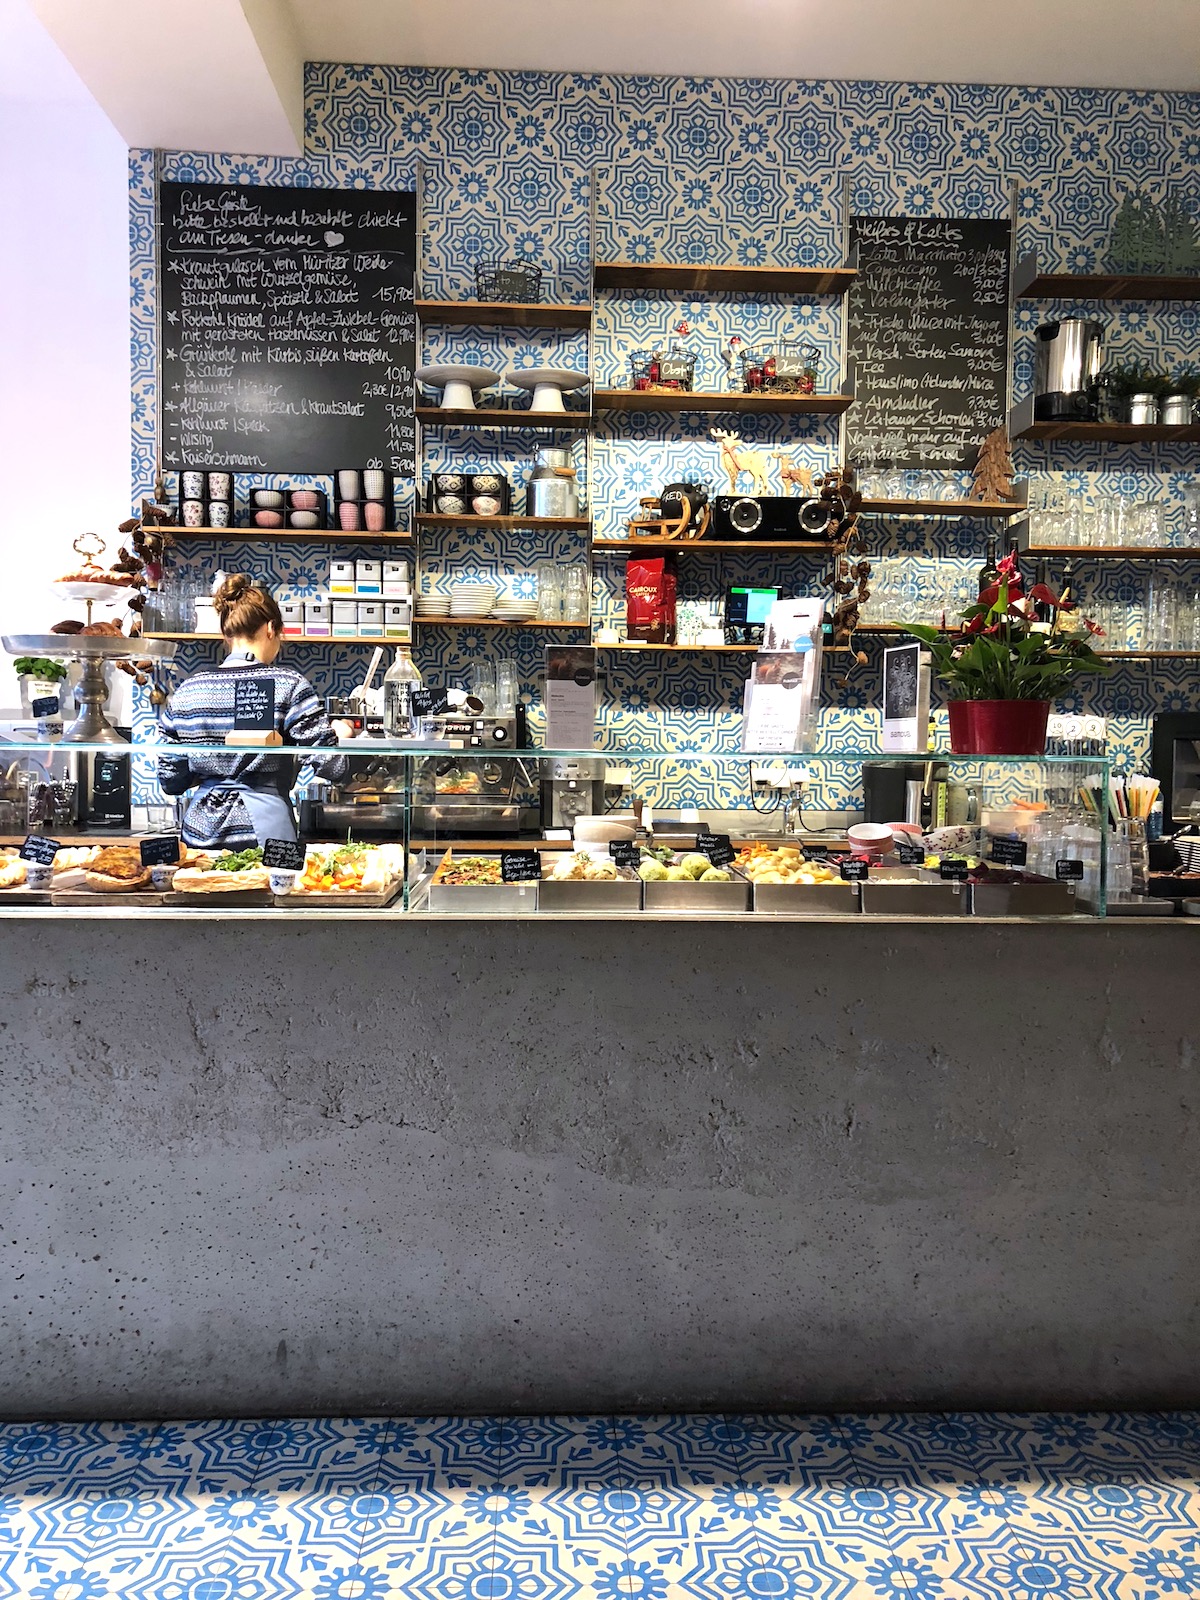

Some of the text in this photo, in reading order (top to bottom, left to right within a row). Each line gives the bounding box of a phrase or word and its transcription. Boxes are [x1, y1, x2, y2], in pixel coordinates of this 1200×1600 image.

[172, 214, 211, 229] bitte
[300, 209, 354, 227] bezahlt
[358, 210, 408, 228] direkt
[206, 229, 254, 246] Tresen
[264, 230, 320, 246] danke
[917, 221, 964, 241] Kaltes
[180, 257, 271, 280] Krautgulasch
[180, 274, 231, 290] schwein
[236, 274, 258, 288] mit
[181, 309, 226, 328] Rotkohl
[270, 310, 294, 330] auf
[944, 314, 965, 331] mit
[181, 328, 202, 342] mit
[204, 326, 265, 348] gerösteten
[268, 326, 338, 344] Haselnüssen
[350, 328, 381, 343] Salat
[179, 344, 238, 363] Grünkohl
[241, 346, 262, 363] mit
[343, 347, 394, 365] Kartoffeln
[185, 362, 196, 378] &
[196, 362, 234, 378] Salat
[662, 362, 686, 377] Obst
[856, 360, 885, 373] Tee
[179, 397, 230, 418] Allgäuer
[309, 398, 366, 417] Krautsalat
[864, 394, 940, 411] Almdudler
[180, 432, 214, 453] Wirsing
[942, 429, 970, 450] auf
[970, 432, 986, 446] de
[366, 457, 384, 470] ab
